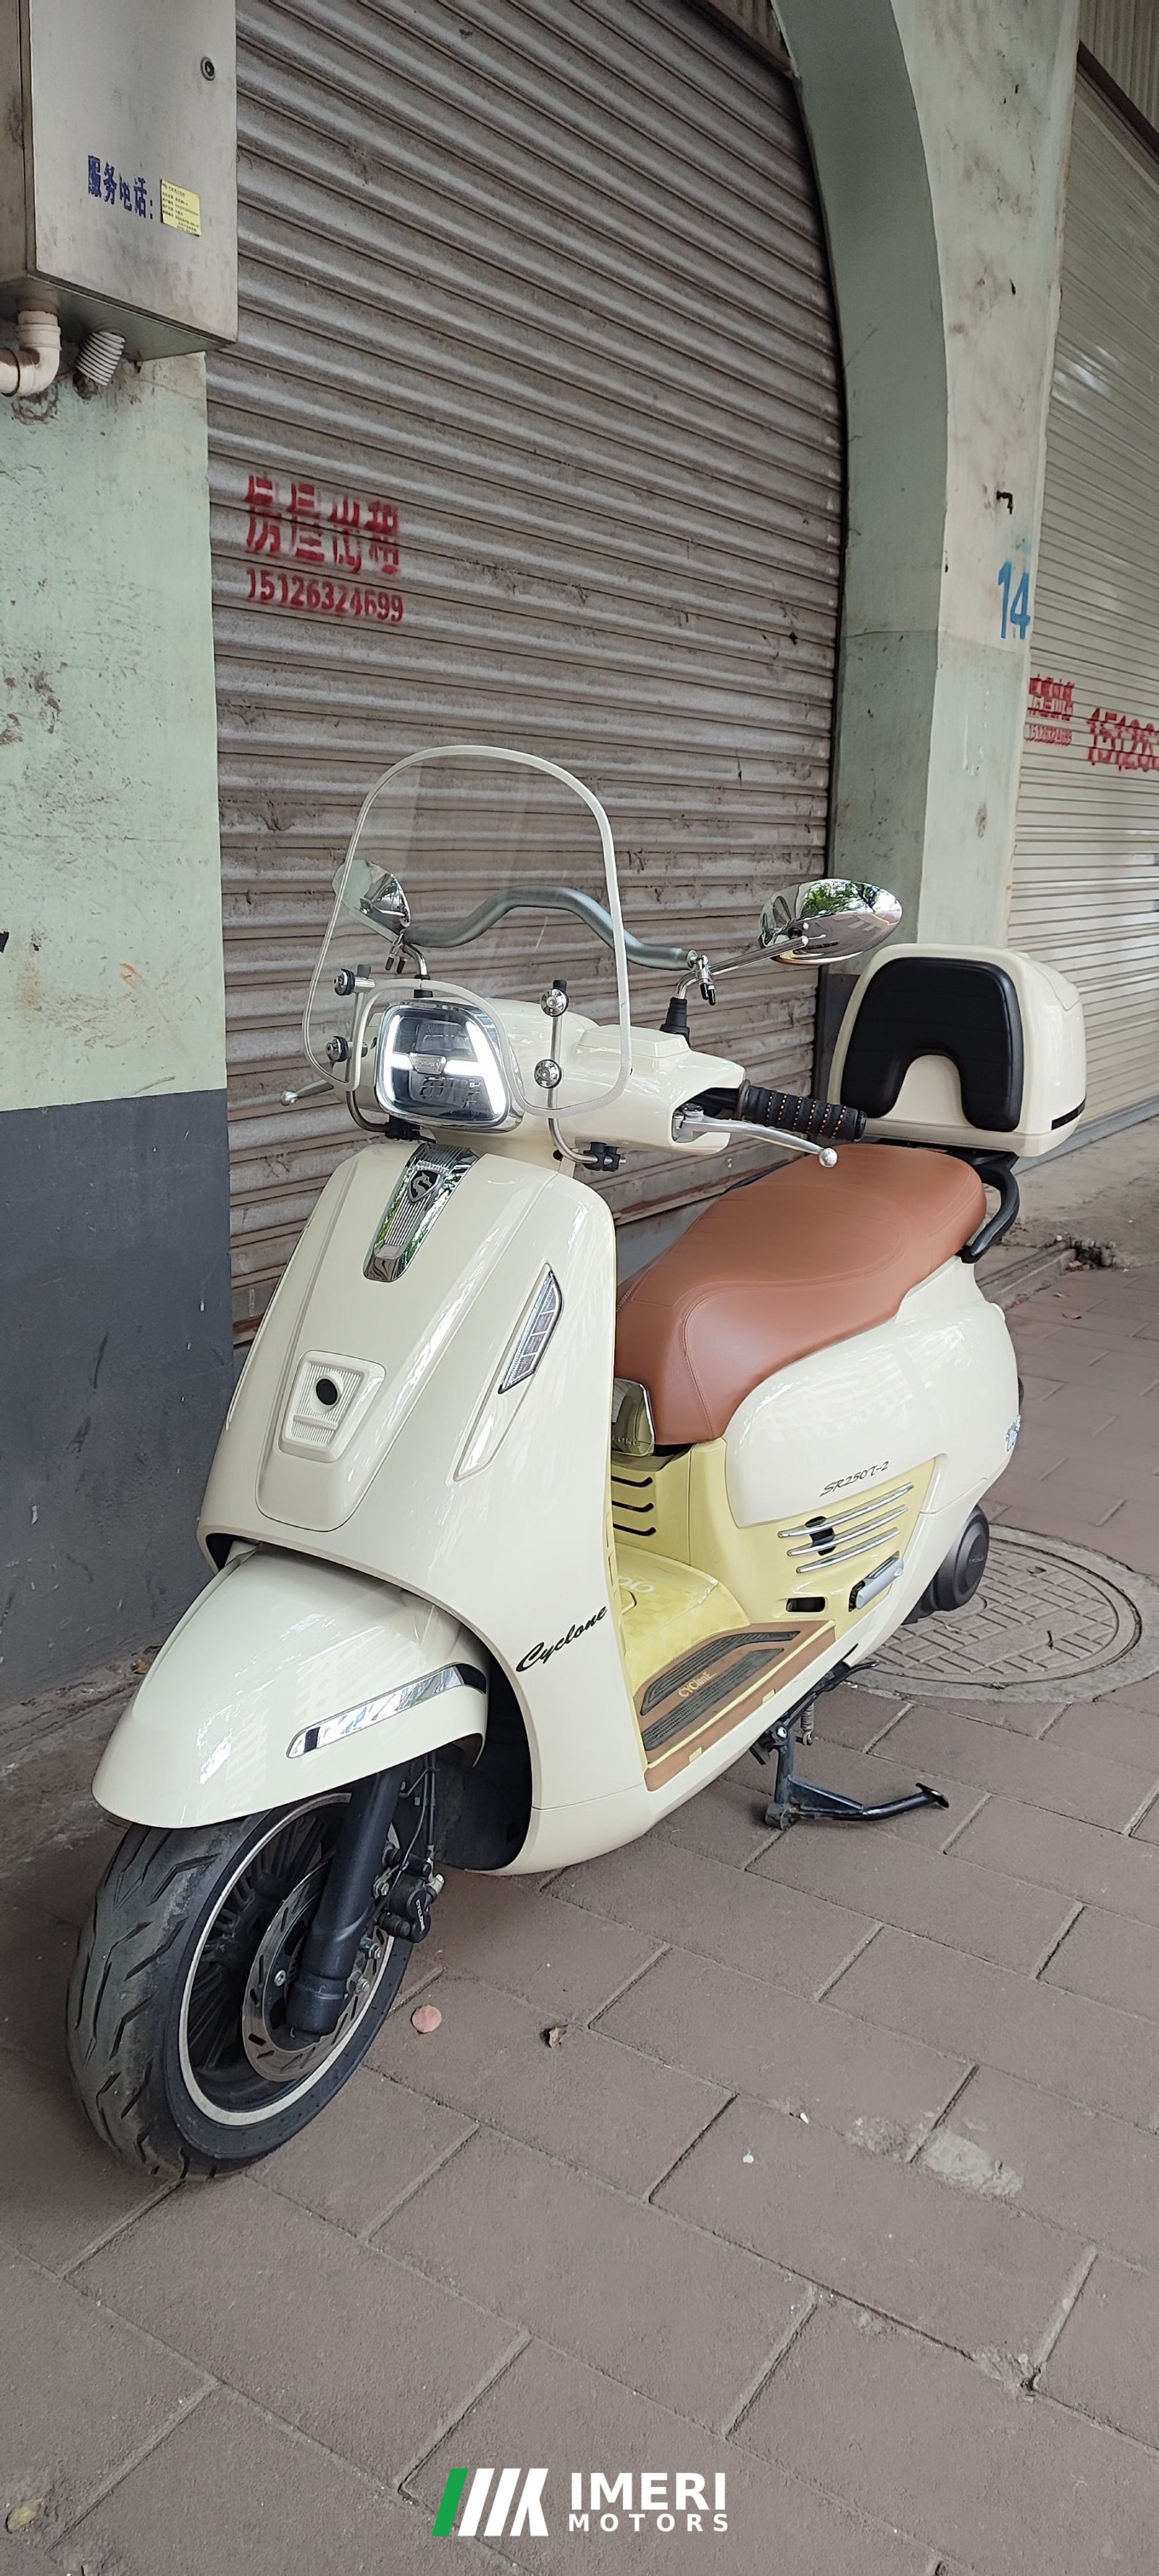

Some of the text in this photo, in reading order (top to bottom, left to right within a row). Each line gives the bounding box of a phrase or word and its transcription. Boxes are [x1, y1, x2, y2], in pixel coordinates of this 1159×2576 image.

[246, 567, 404, 625] 15126324699
[997, 559, 1032, 640] 14
[819, 1460, 890, 1497] SR250T-2
[515, 1605, 608, 1673] Cyclone
